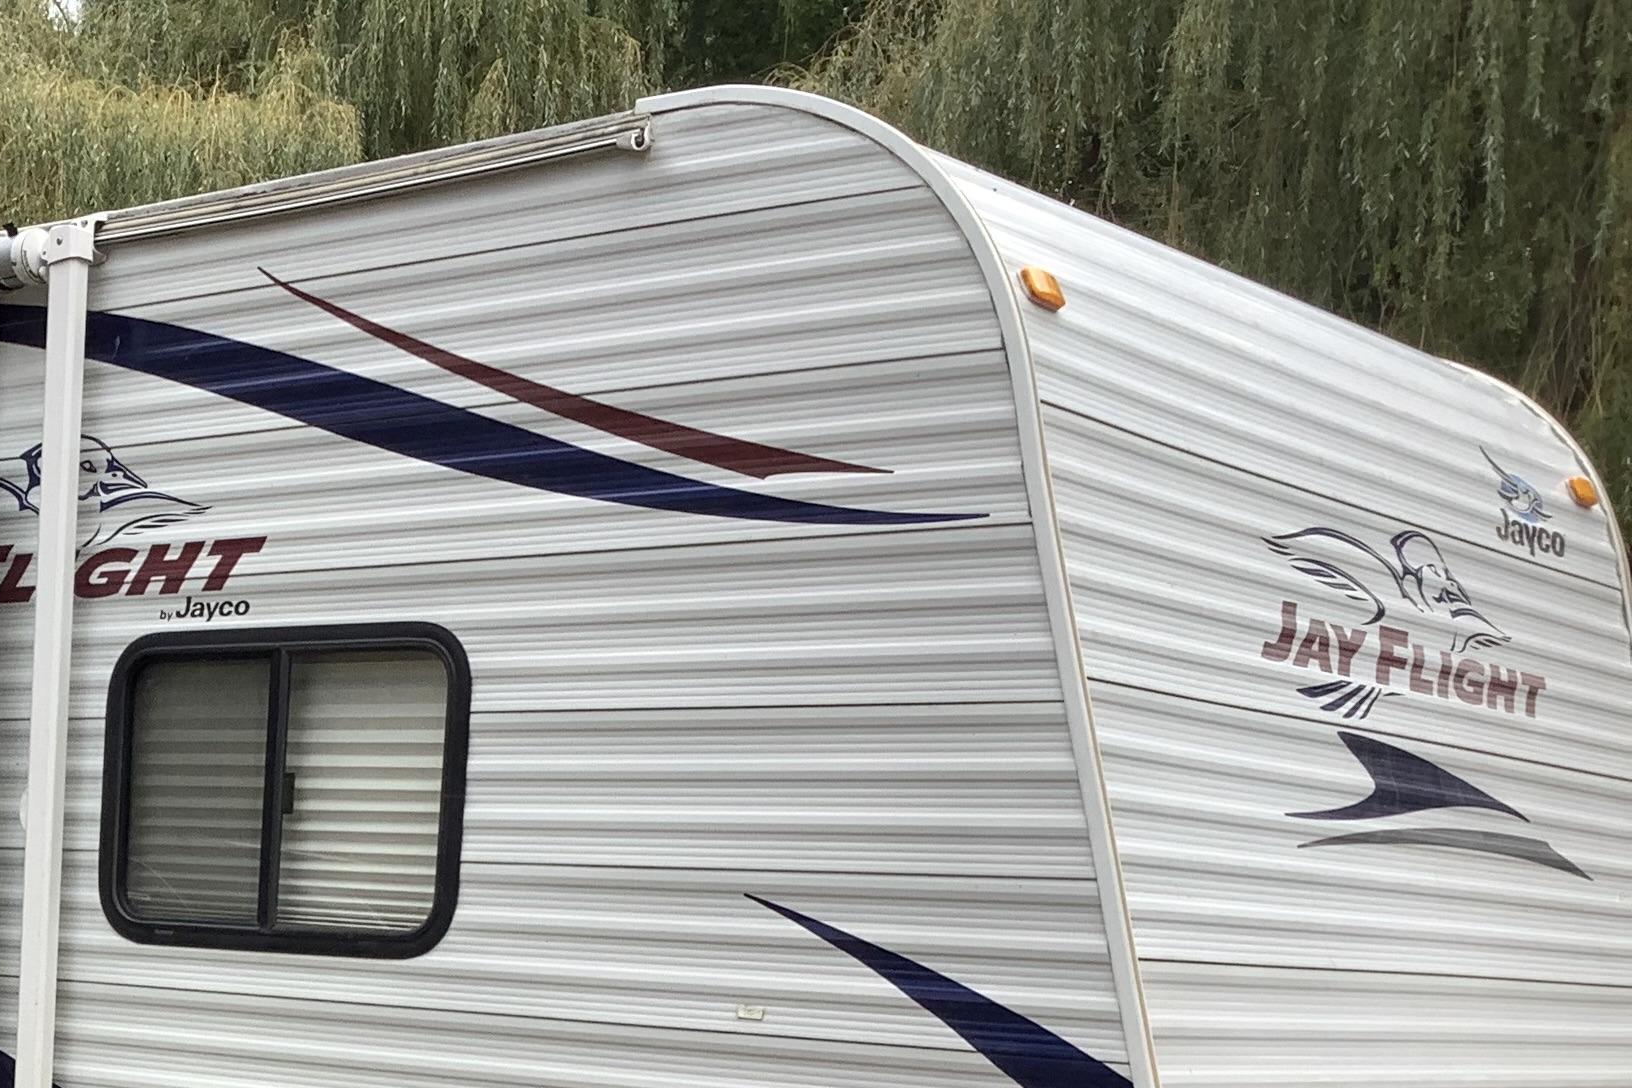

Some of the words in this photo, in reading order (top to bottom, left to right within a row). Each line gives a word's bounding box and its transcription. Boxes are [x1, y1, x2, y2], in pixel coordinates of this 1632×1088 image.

[1496, 509, 1566, 558] Jayco
[159, 610, 174, 622] by
[175, 596, 250, 622] Jayco
[1260, 600, 1368, 678] JAY
